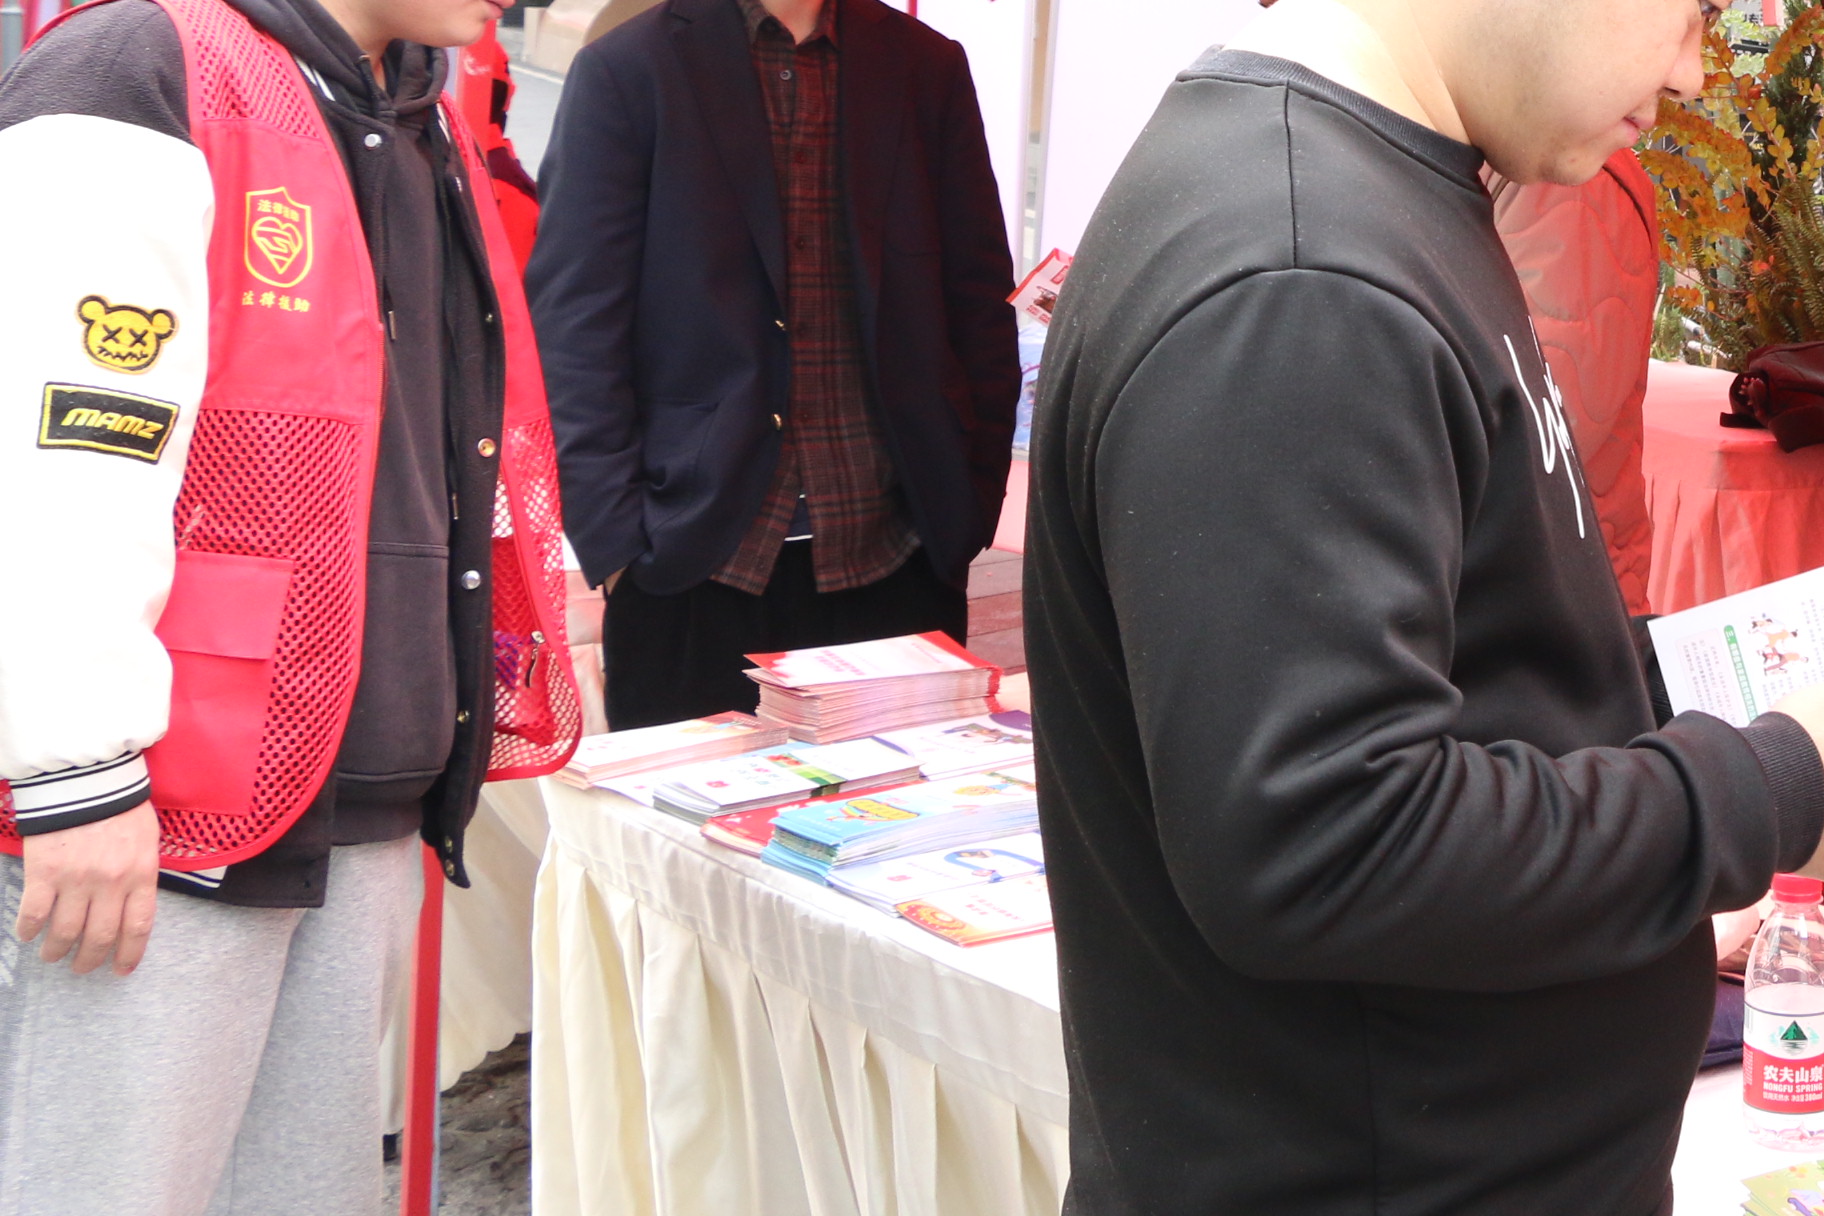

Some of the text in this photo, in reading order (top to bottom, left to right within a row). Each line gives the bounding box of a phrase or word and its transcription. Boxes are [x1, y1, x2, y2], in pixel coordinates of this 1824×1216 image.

[1763, 1065, 1824, 1083] 农夫山泉
[1763, 1081, 1823, 1093] NONGFU SPRING
